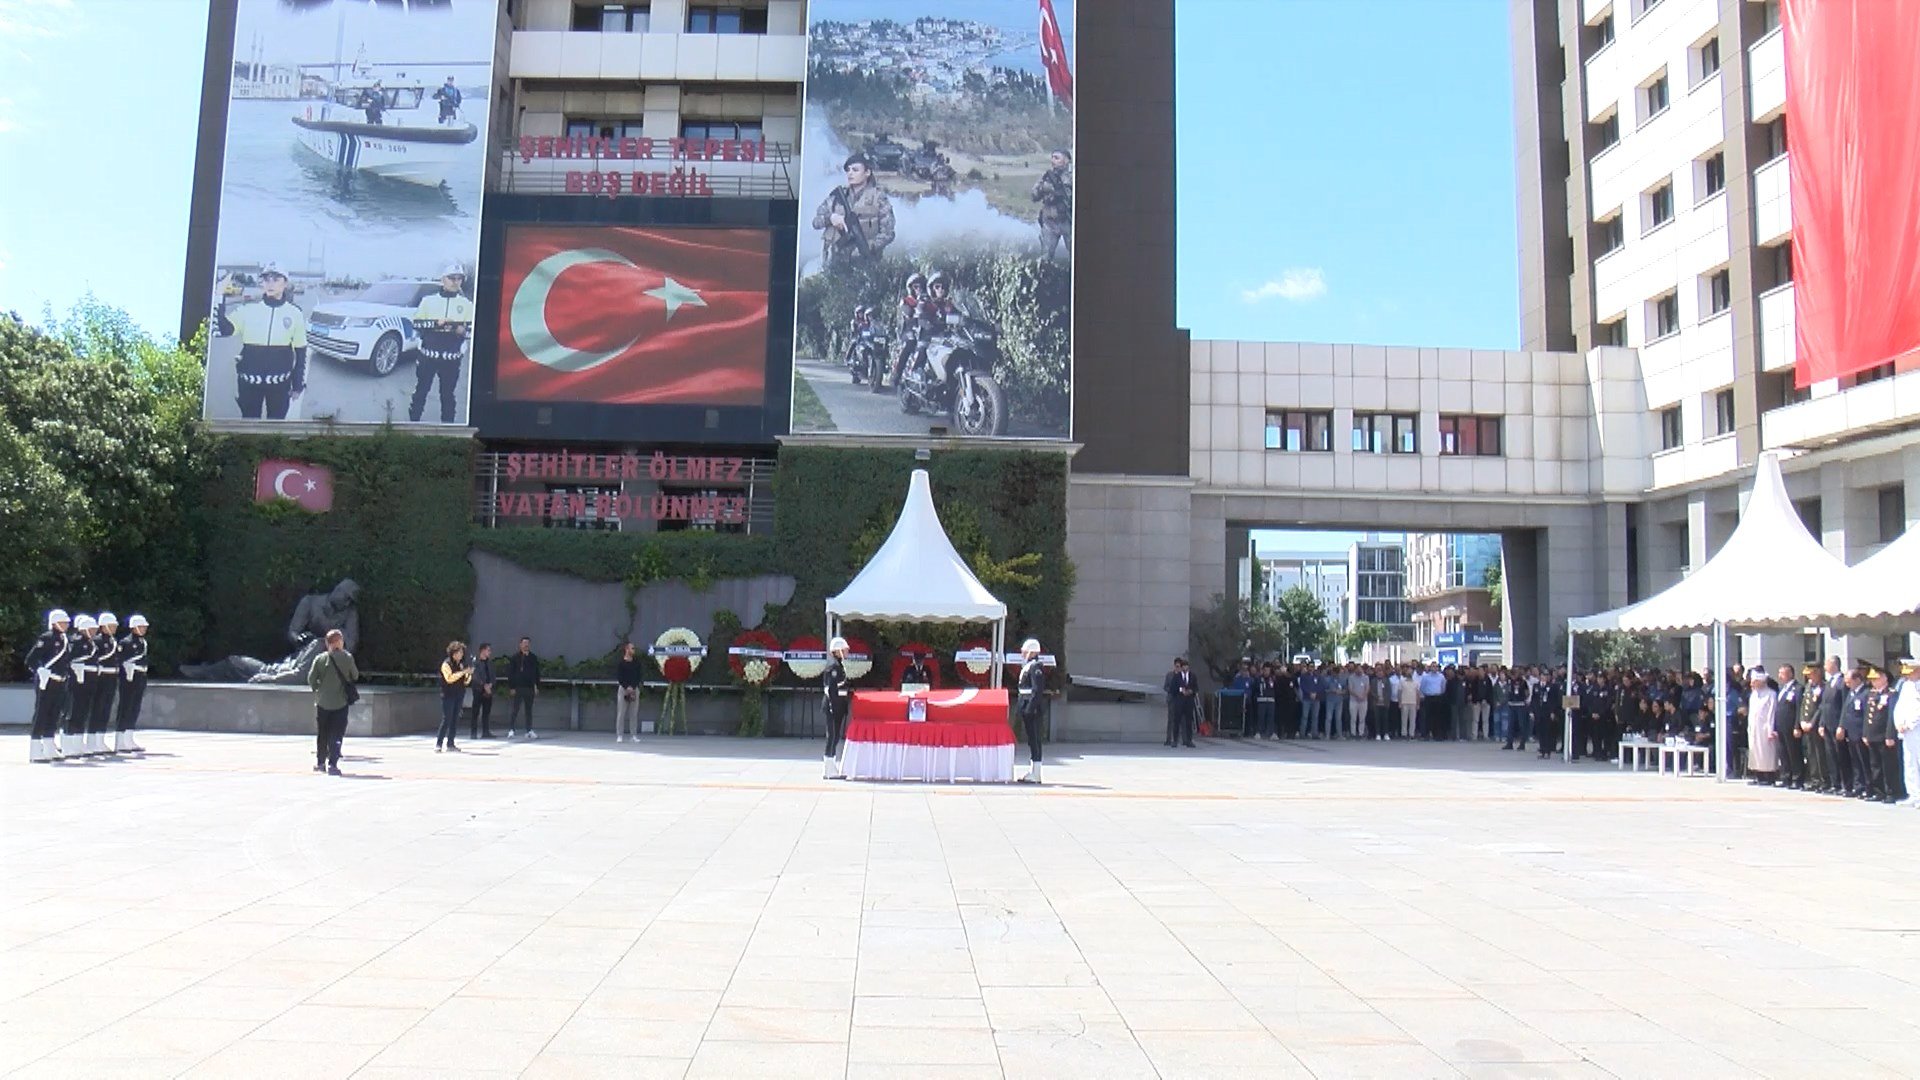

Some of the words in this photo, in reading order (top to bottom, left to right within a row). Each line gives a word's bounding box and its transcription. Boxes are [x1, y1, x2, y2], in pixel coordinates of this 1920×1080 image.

[519, 133, 653, 163] ŞEHİTLER
[669, 135, 765, 162] TEPESİ
[566, 171, 621, 198] BOŞ
[632, 167, 713, 195] DEĞİL
[507, 450, 638, 482] ŞEHİTLER
[650, 452, 743, 482] ÖLMEZ
[499, 493, 586, 518] VATAN
